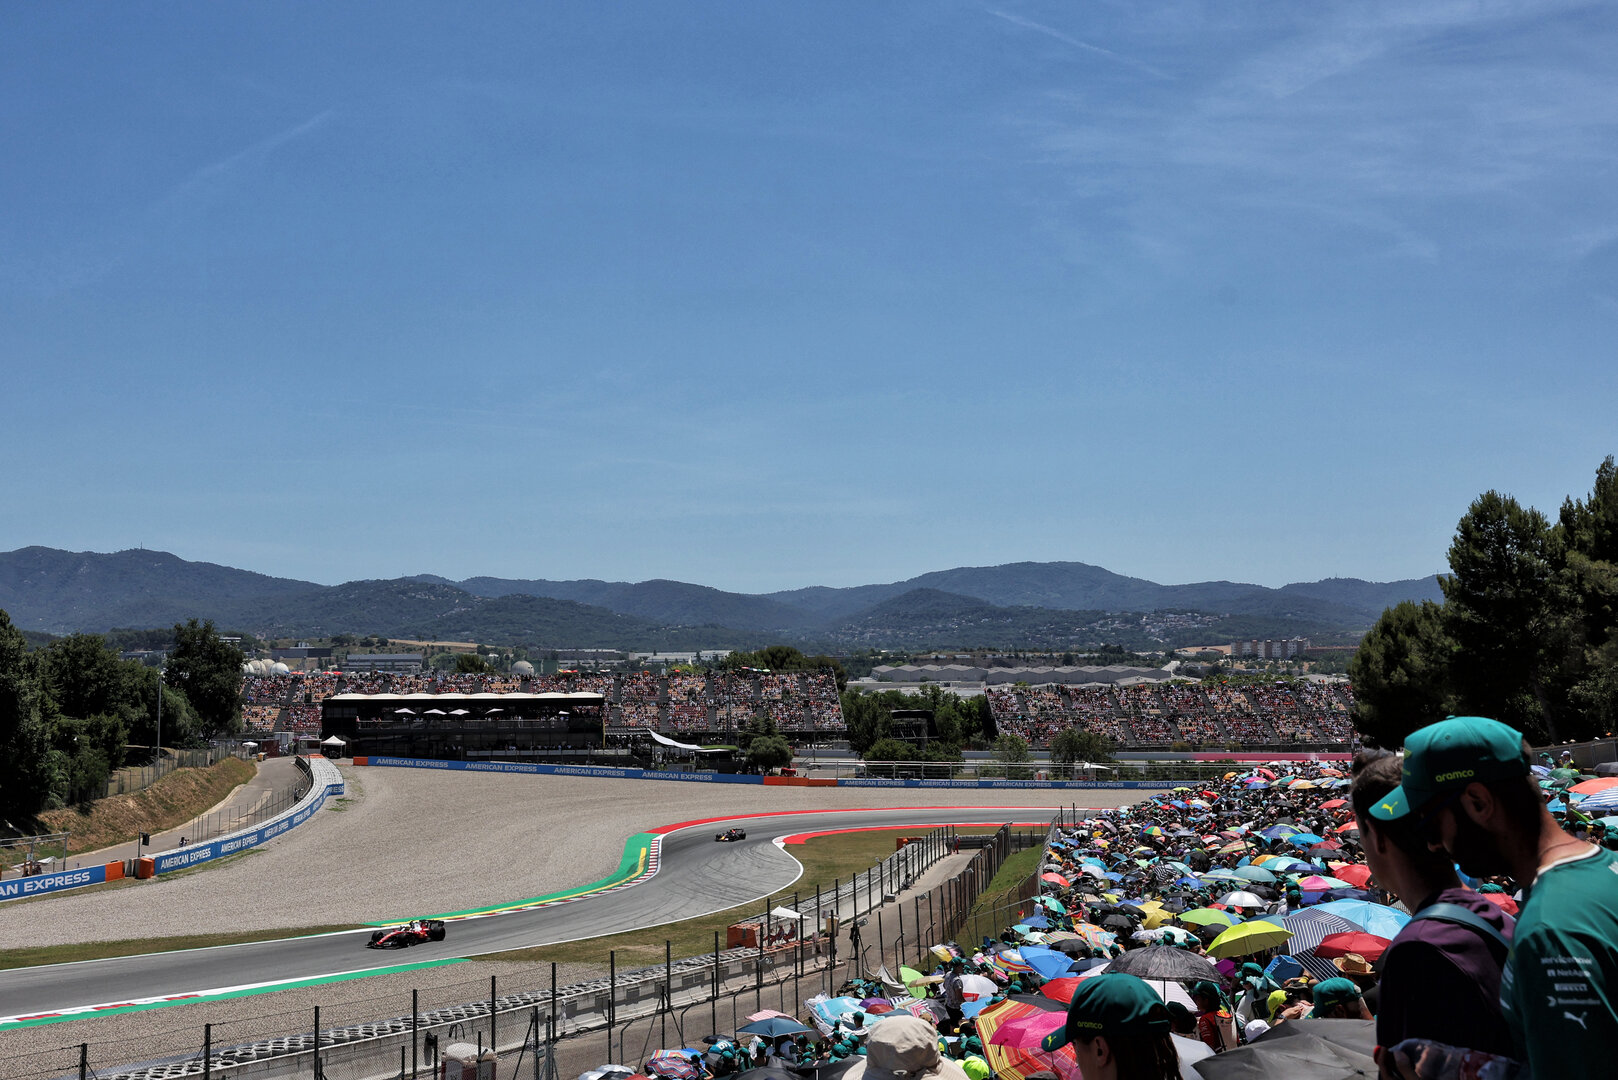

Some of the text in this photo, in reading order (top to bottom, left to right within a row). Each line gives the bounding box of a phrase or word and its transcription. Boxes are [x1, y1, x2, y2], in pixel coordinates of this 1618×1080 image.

[376, 758, 449, 768] AMERICAN EXPRESS
[465, 763, 538, 773] AMERICAN EXPRESS
[553, 767, 626, 777] AMERICAN EXPRESS
[641, 771, 713, 781] AMERICAN EXPRESS
[1435, 769, 1475, 782] aramco
[160, 847, 212, 870] AMERICAN EXPRESS
[23, 871, 91, 892] EXPRESS
